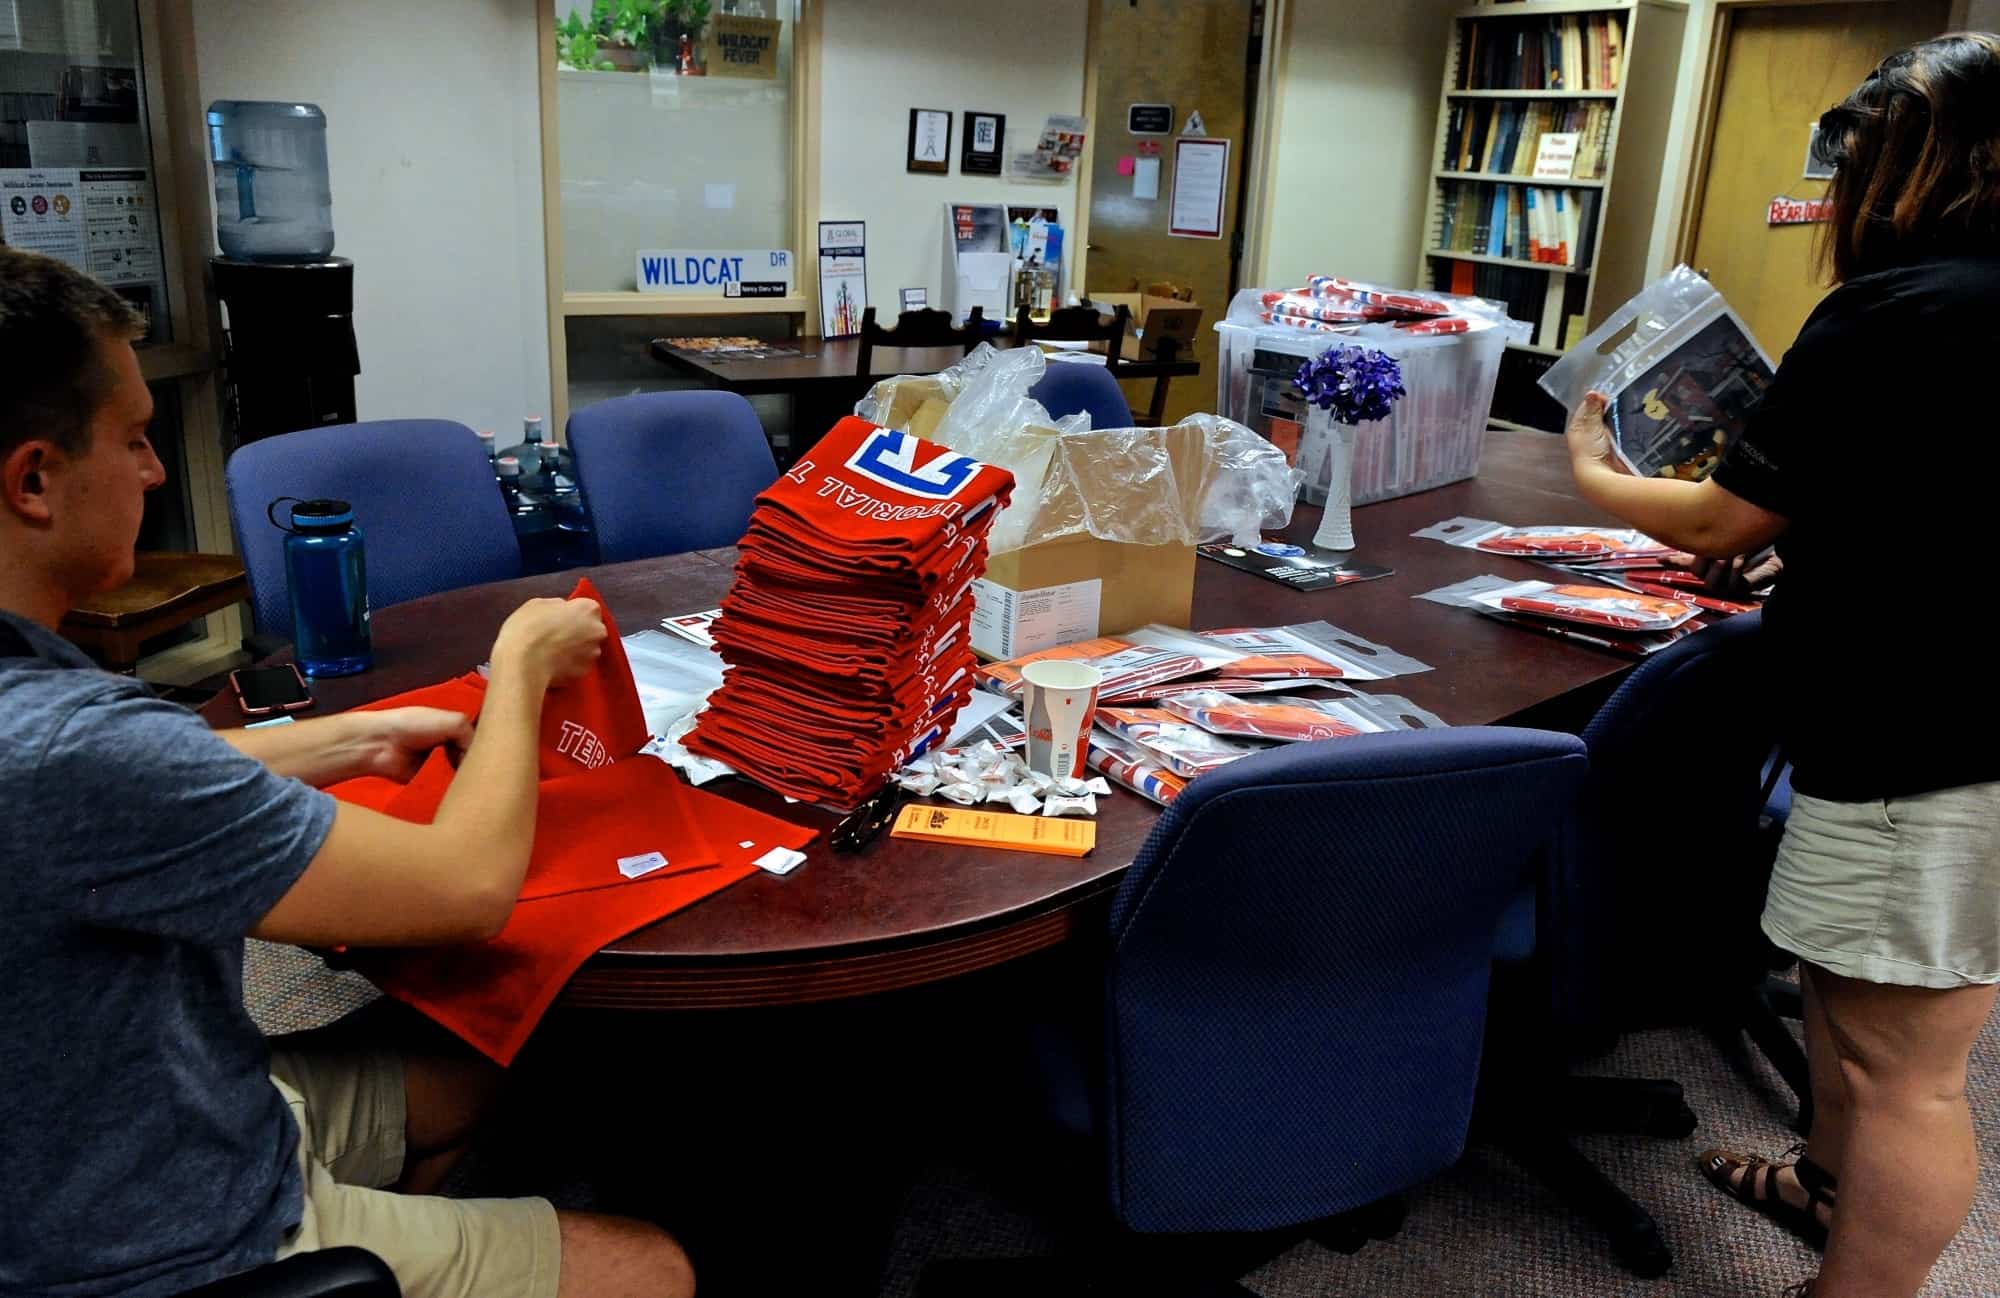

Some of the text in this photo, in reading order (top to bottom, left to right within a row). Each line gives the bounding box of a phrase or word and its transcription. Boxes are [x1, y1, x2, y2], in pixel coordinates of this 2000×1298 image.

[717, 31, 770, 49] WILDCAT
[723, 48, 760, 65] FEVER
[1770, 201, 1803, 223] BEAR
[642, 252, 787, 286] WILDCAT DR
[556, 720, 615, 769] TER
